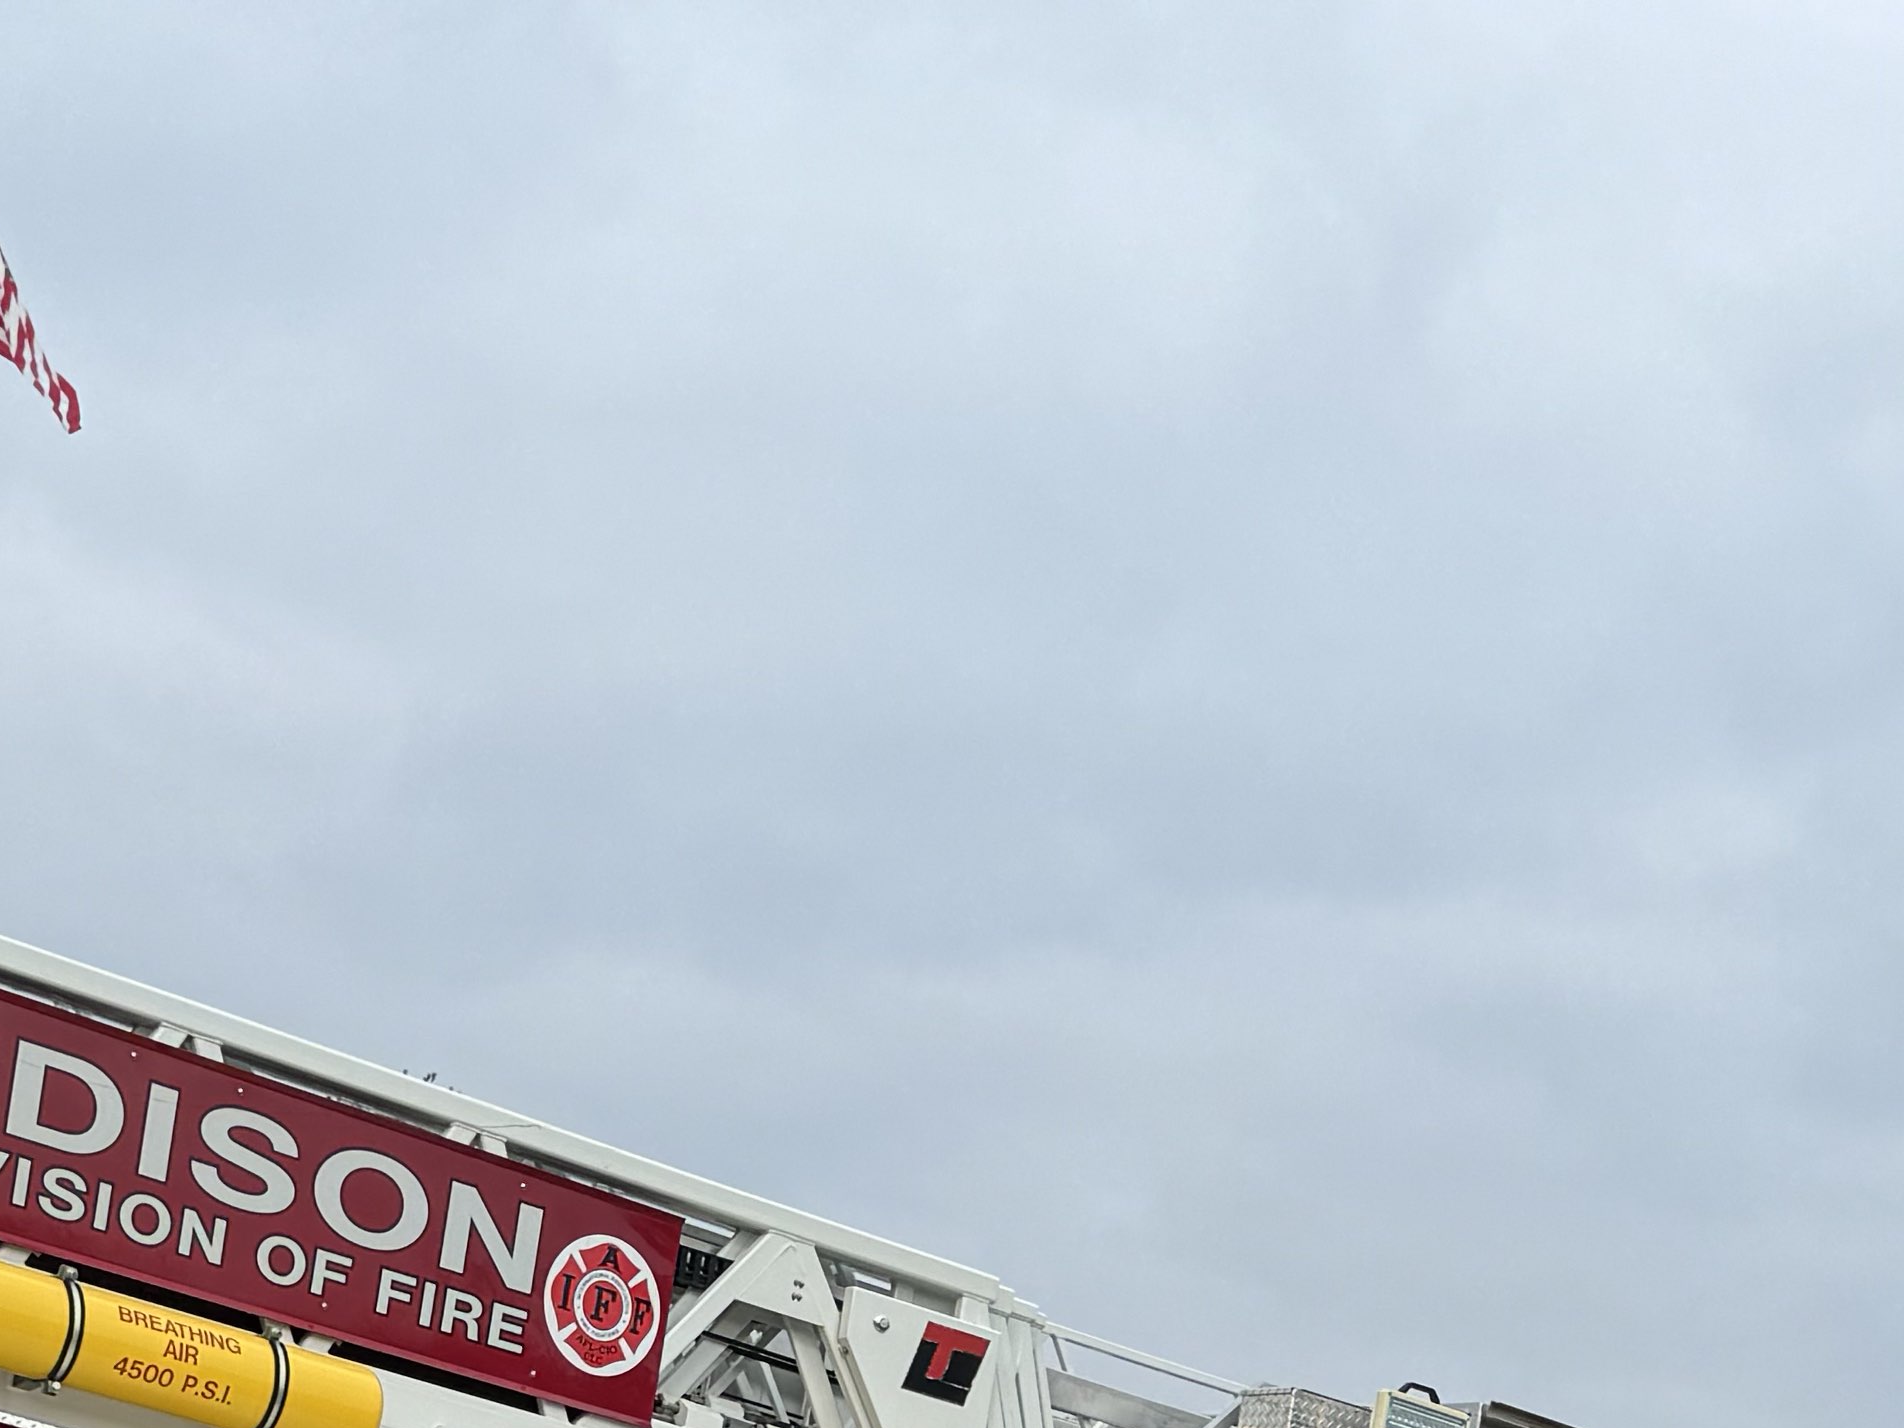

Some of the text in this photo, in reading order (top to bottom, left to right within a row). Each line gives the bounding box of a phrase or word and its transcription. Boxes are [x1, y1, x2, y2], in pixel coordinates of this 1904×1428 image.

[255, 1234, 354, 1296] OF
[374, 1267, 529, 1355] FIRE
[118, 1305, 242, 1355] BREATHING
[162, 1339, 199, 1366] AIR
[113, 1356, 232, 1406] 4500 P.S.I.
